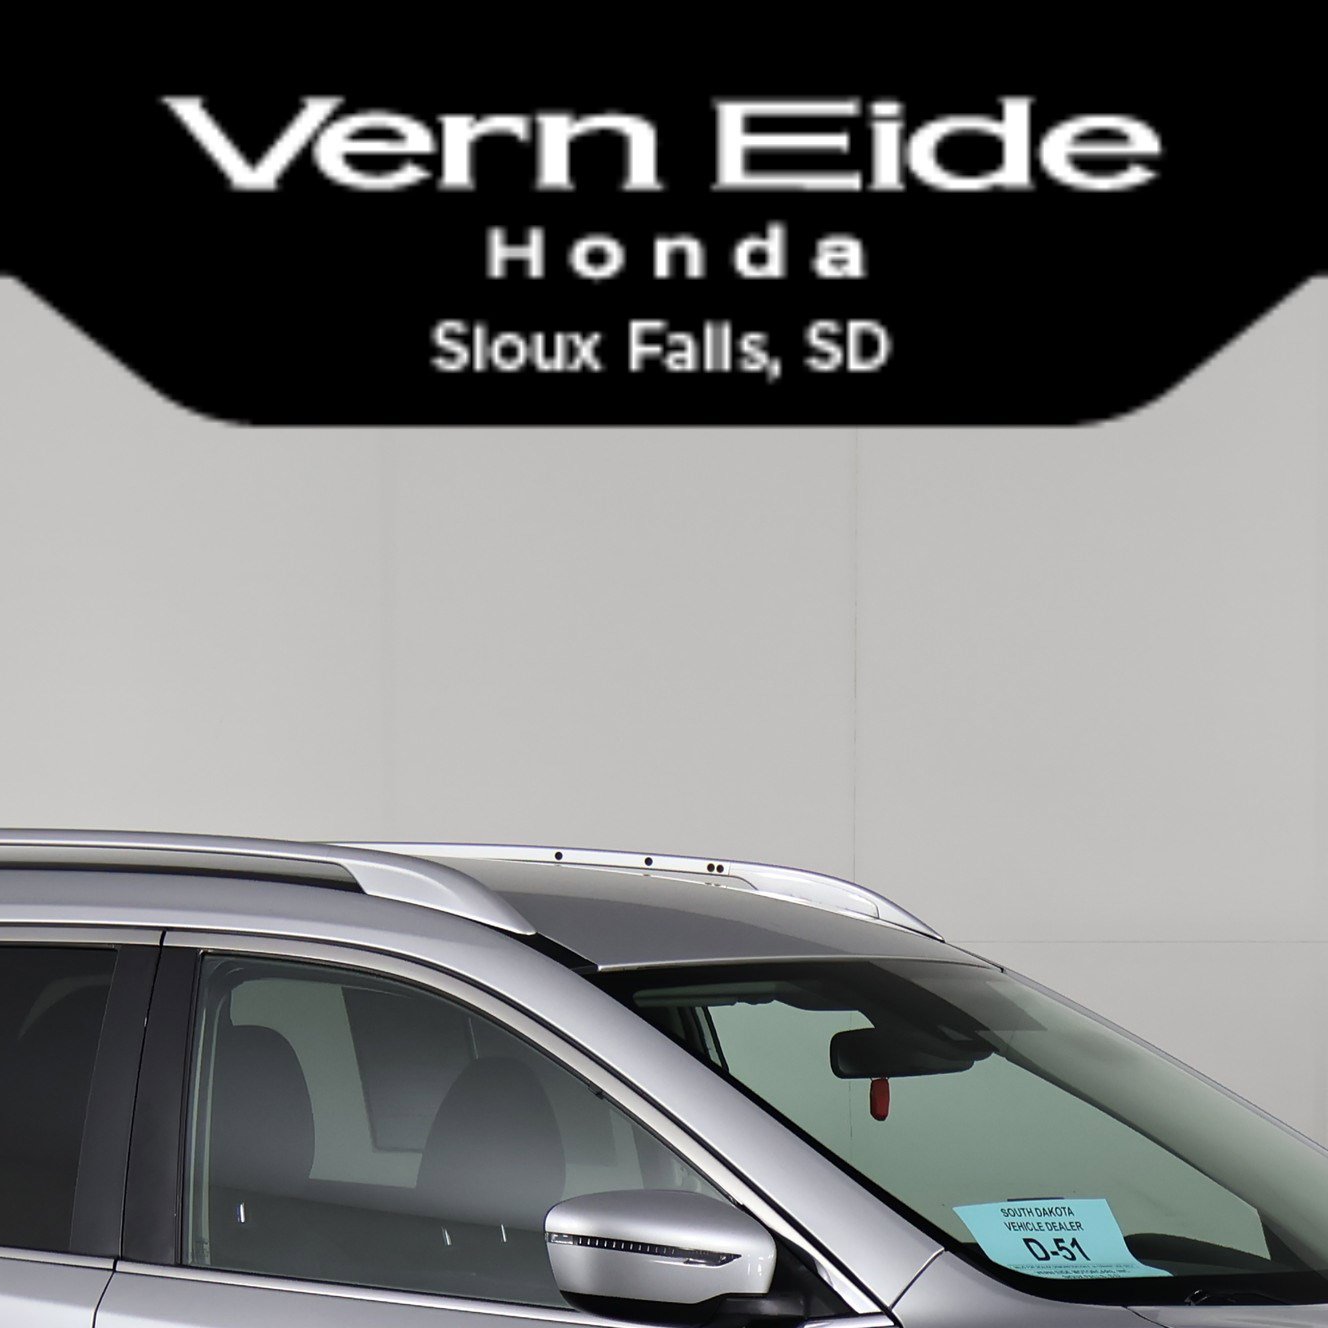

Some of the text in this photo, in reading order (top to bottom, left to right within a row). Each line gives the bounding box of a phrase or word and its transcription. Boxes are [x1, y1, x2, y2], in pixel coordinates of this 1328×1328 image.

[1000, 1206, 1075, 1218] SOUTH DAKOTA
[1003, 1221, 1084, 1232] VEHICLE DEALER
[1022, 1237, 1091, 1261] D-51
